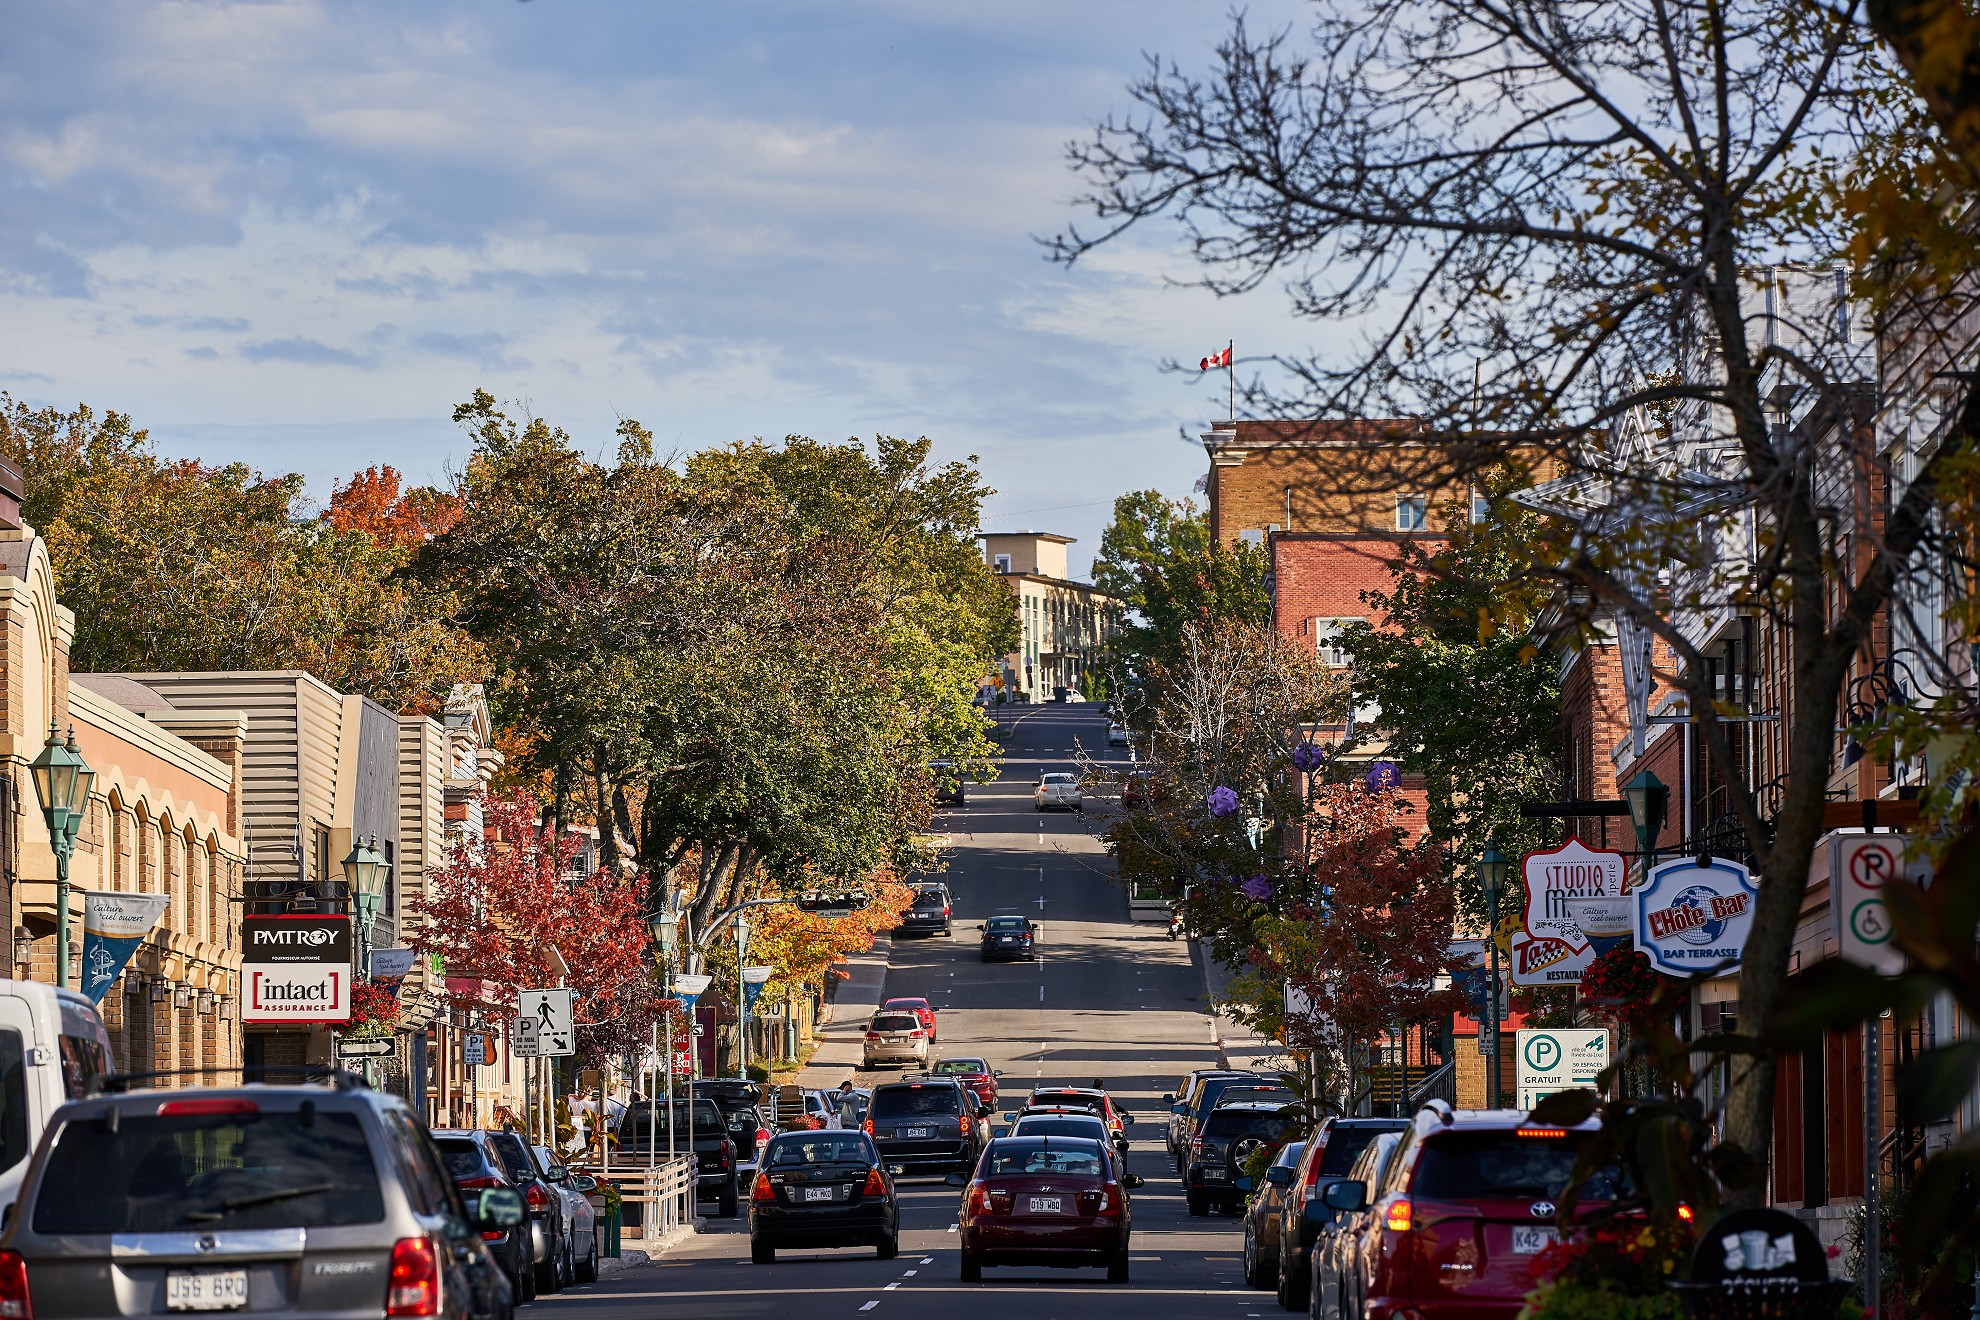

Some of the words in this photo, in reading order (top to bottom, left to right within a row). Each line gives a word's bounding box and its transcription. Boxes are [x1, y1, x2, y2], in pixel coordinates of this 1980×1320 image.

[1545, 864, 1603, 889] STUDIO
[93, 903, 124, 913] Culture
[1582, 907, 1609, 915] Culture
[1709, 891, 1750, 921] Bar
[101, 912, 116, 921] ciel
[118, 914, 145, 922] ouvert
[1663, 949, 1685, 959] BAR
[1686, 948, 1738, 958] TERRASSE
[1546, 970, 1587, 981] RESTAURA
[263, 977, 329, 1001] intact
[263, 1004, 327, 1012] ASSURANCE
[520, 1021, 531, 1035] P
[470, 1037, 478, 1047] P
[1536, 1042, 1552, 1064] P
[1524, 1076, 1562, 1084] GRATUIT
[1515, 1231, 1541, 1248] K42
